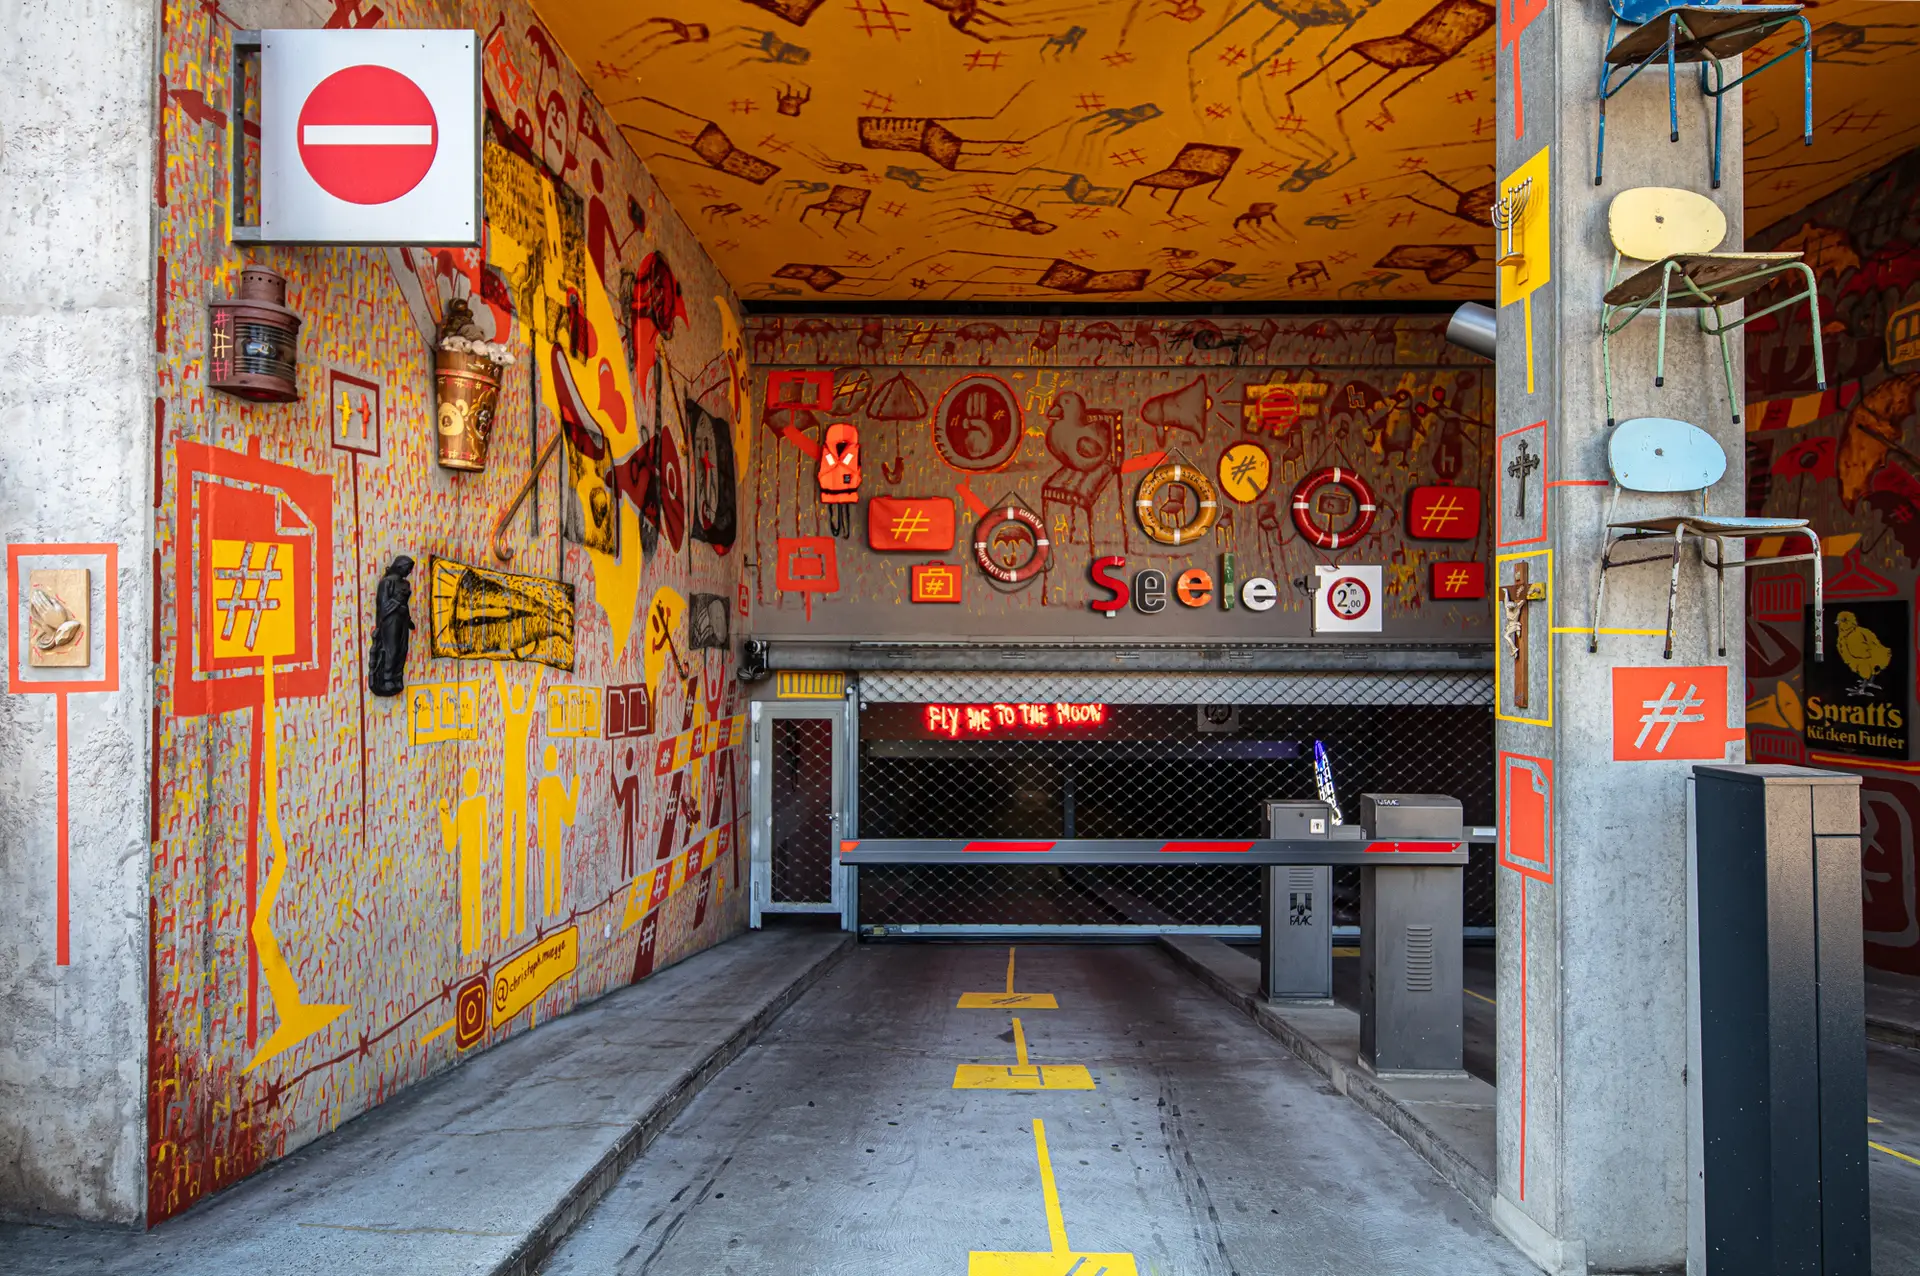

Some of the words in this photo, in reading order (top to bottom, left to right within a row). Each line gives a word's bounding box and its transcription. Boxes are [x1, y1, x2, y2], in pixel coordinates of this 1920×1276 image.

[1091, 552, 1277, 614] Seele
[928, 705, 960, 737] FLY
[966, 707, 991, 731] ME
[993, 703, 1015, 725] TO
[1018, 704, 1049, 726] THE
[1056, 702, 1103, 725] MOON
[1807, 696, 1903, 728] Spratt's
[1858, 730, 1905, 750] Futter
[1289, 915, 1313, 926] FAAC
